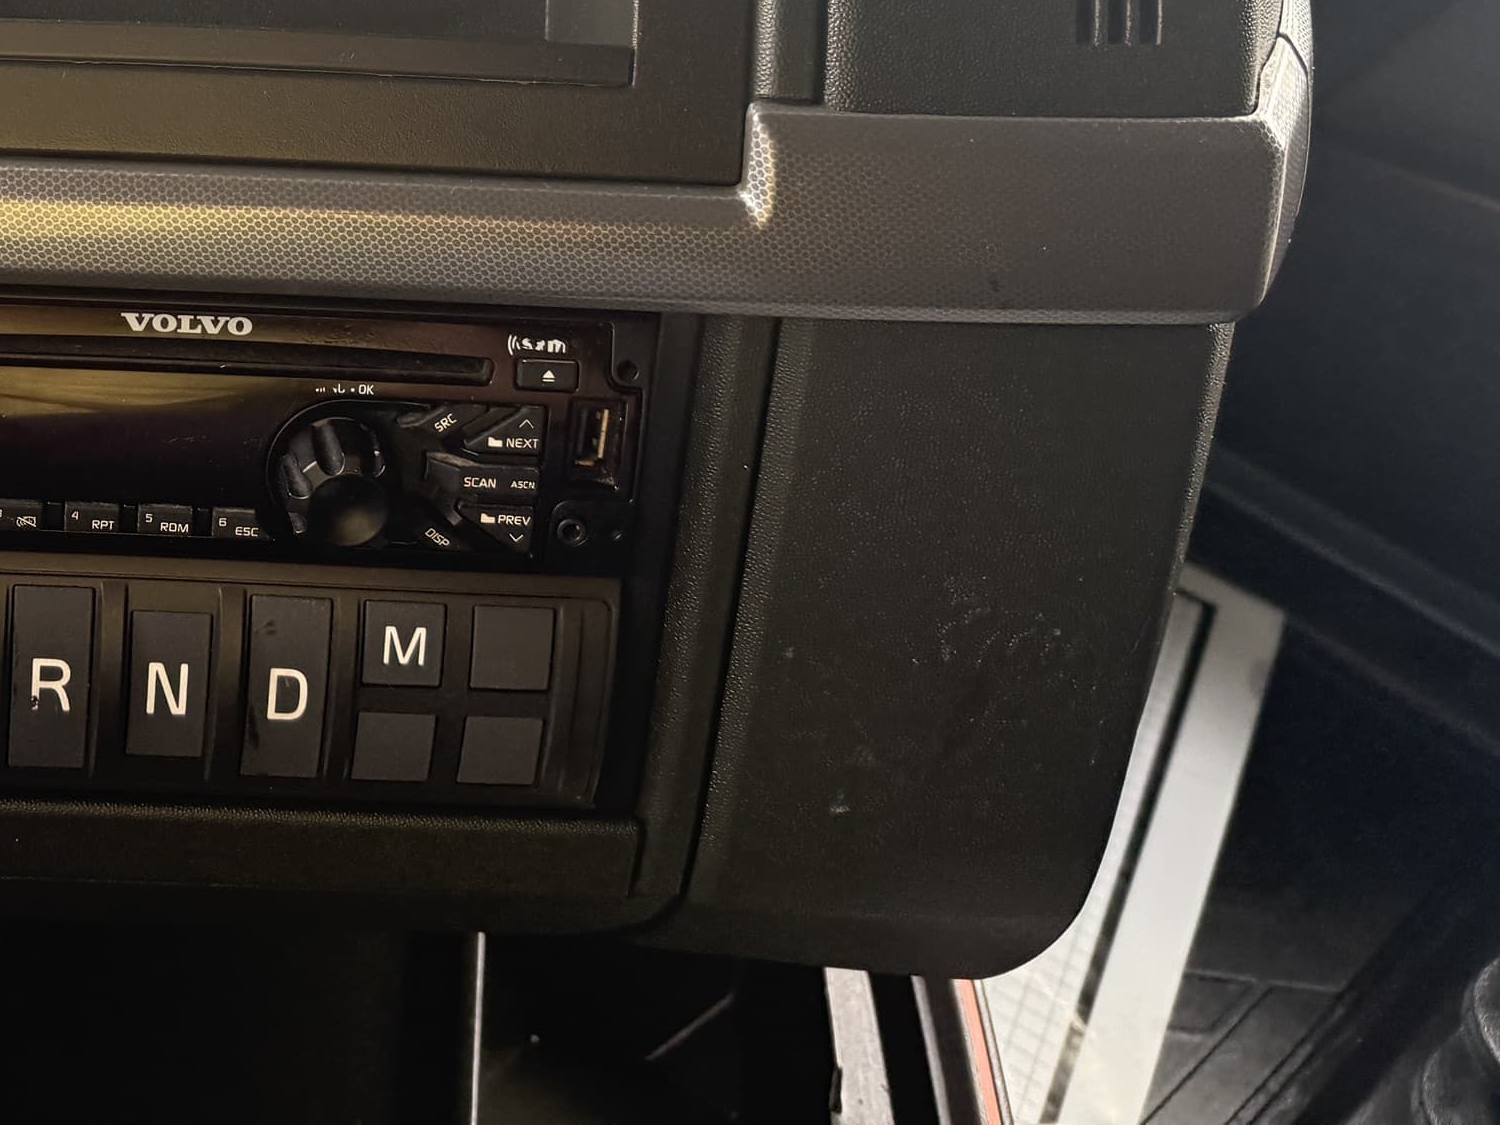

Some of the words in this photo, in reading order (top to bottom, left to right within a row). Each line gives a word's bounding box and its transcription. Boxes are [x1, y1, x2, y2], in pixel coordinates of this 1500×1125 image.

[120, 312, 253, 336] VOLVO
[434, 413, 457, 433] SRC
[506, 437, 539, 449] NEXT
[463, 476, 497, 489] SCAN
[71, 510, 79, 520] 4
[145, 513, 153, 523] 5
[497, 514, 531, 526] PREV
[91, 519, 115, 530] RPT
[160, 522, 189, 533] RDM
[218, 517, 227, 527] 6
[234, 526, 259, 537] ESC
[424, 527, 450, 546] DISP
[383, 625, 427, 666] M
[31, 657, 71, 712] R
[146, 661, 189, 716] N
[266, 667, 308, 721] D
